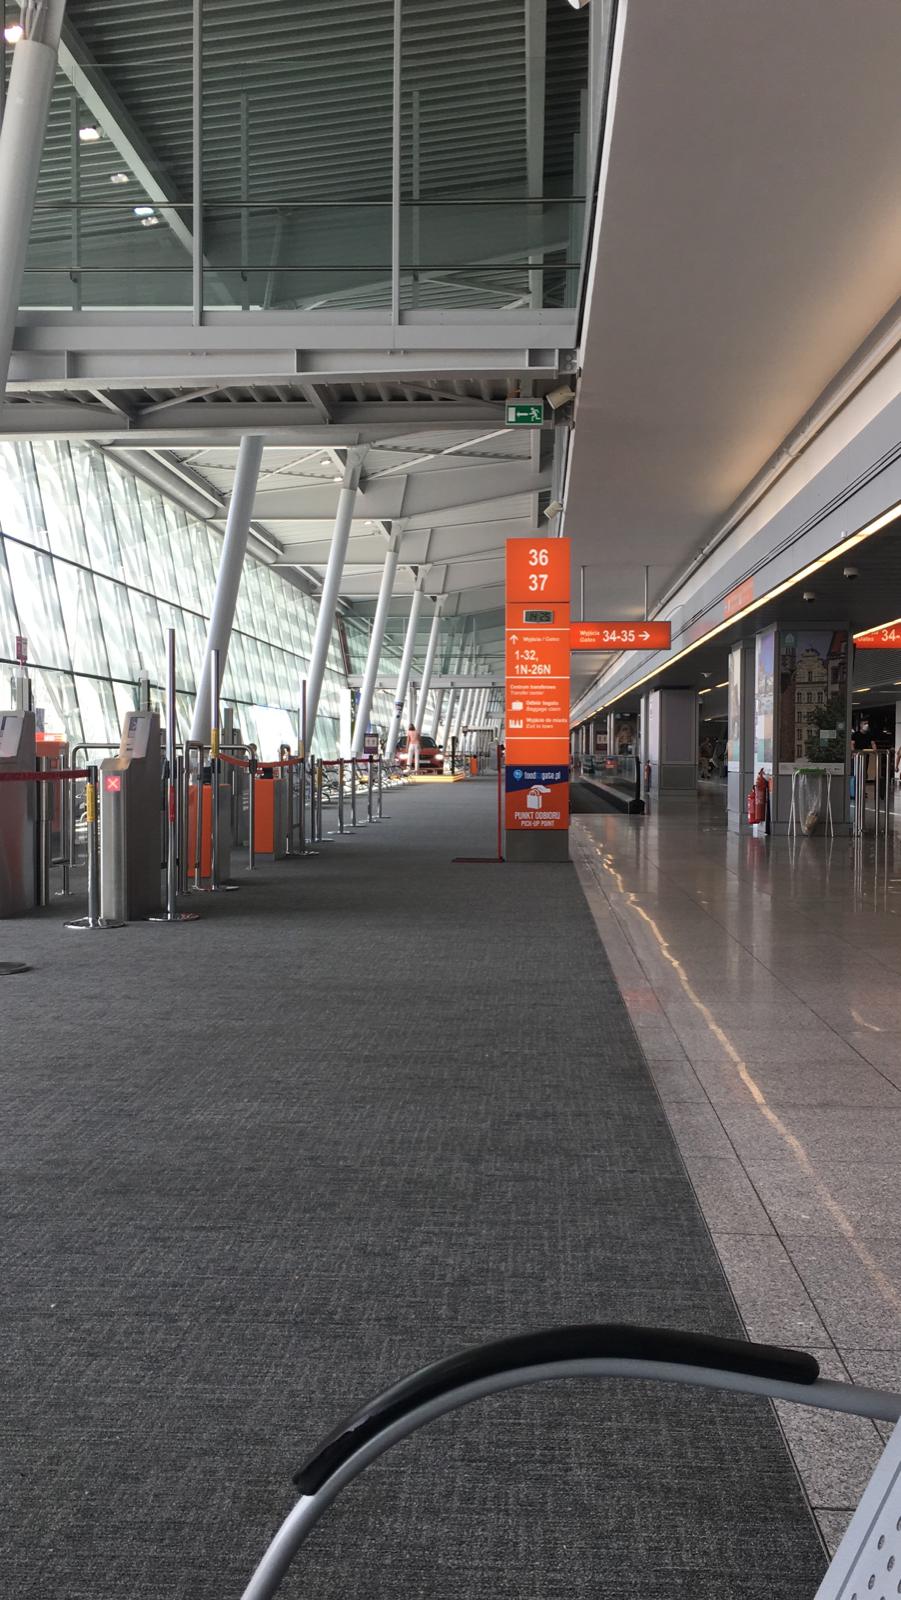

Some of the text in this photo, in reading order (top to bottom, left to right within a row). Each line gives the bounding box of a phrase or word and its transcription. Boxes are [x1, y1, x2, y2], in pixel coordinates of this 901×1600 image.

[528, 549, 549, 566] 36
[528, 574, 548, 591] 37
[602, 630, 635, 643] 34-35
[514, 650, 538, 661] 1-32,
[514, 664, 551, 675] 1N-26N
[514, 812, 534, 820] PUNKT
